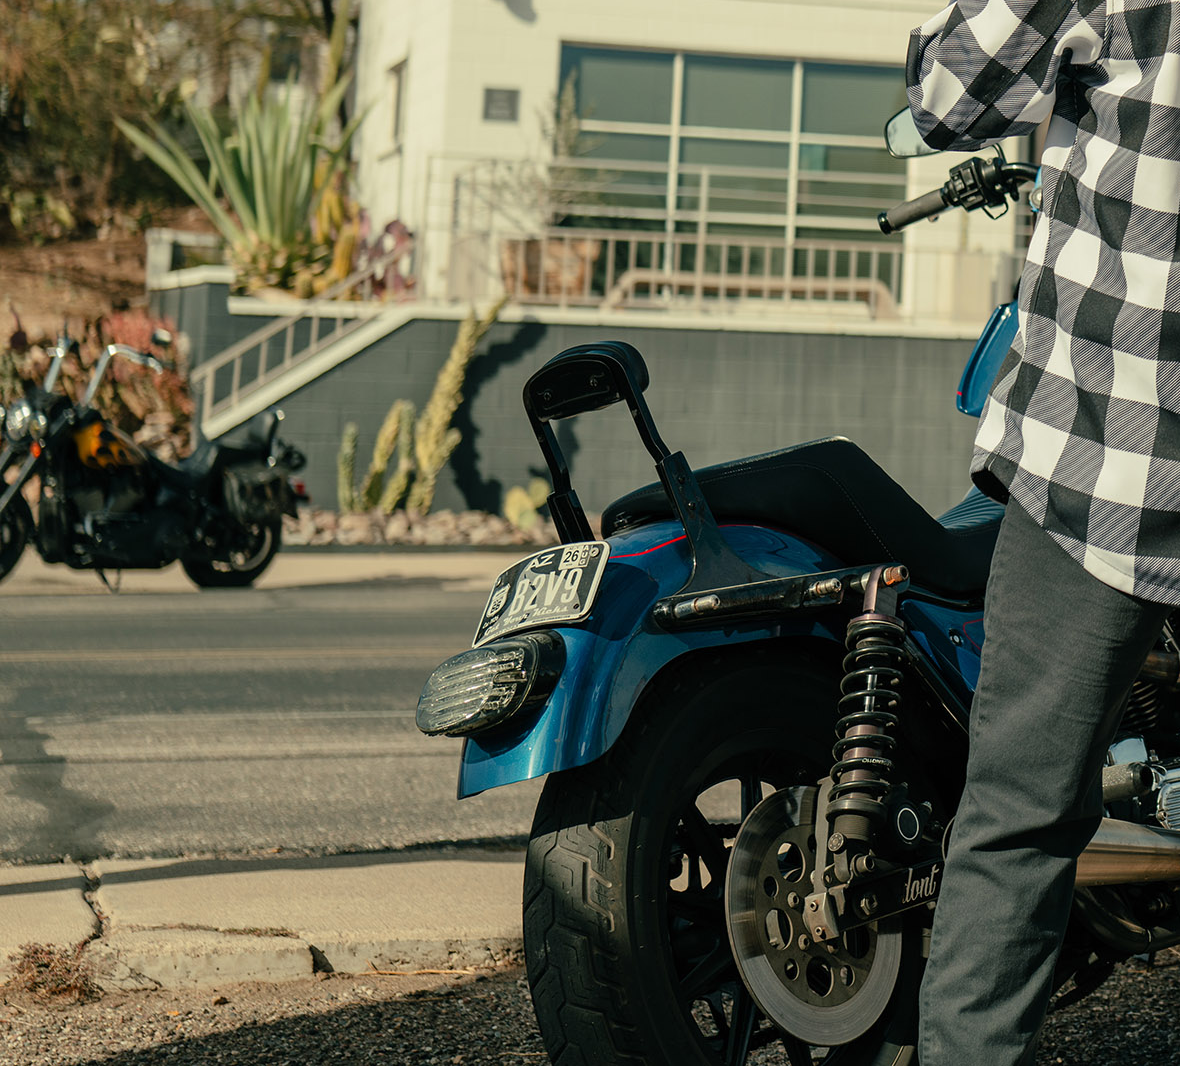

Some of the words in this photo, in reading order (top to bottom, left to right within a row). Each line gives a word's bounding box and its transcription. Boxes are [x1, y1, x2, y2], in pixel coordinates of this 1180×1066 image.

[525, 553, 556, 572] AZ
[563, 550, 580, 563] 26
[579, 544, 589, 565] AUG
[508, 568, 583, 616] B2V9
